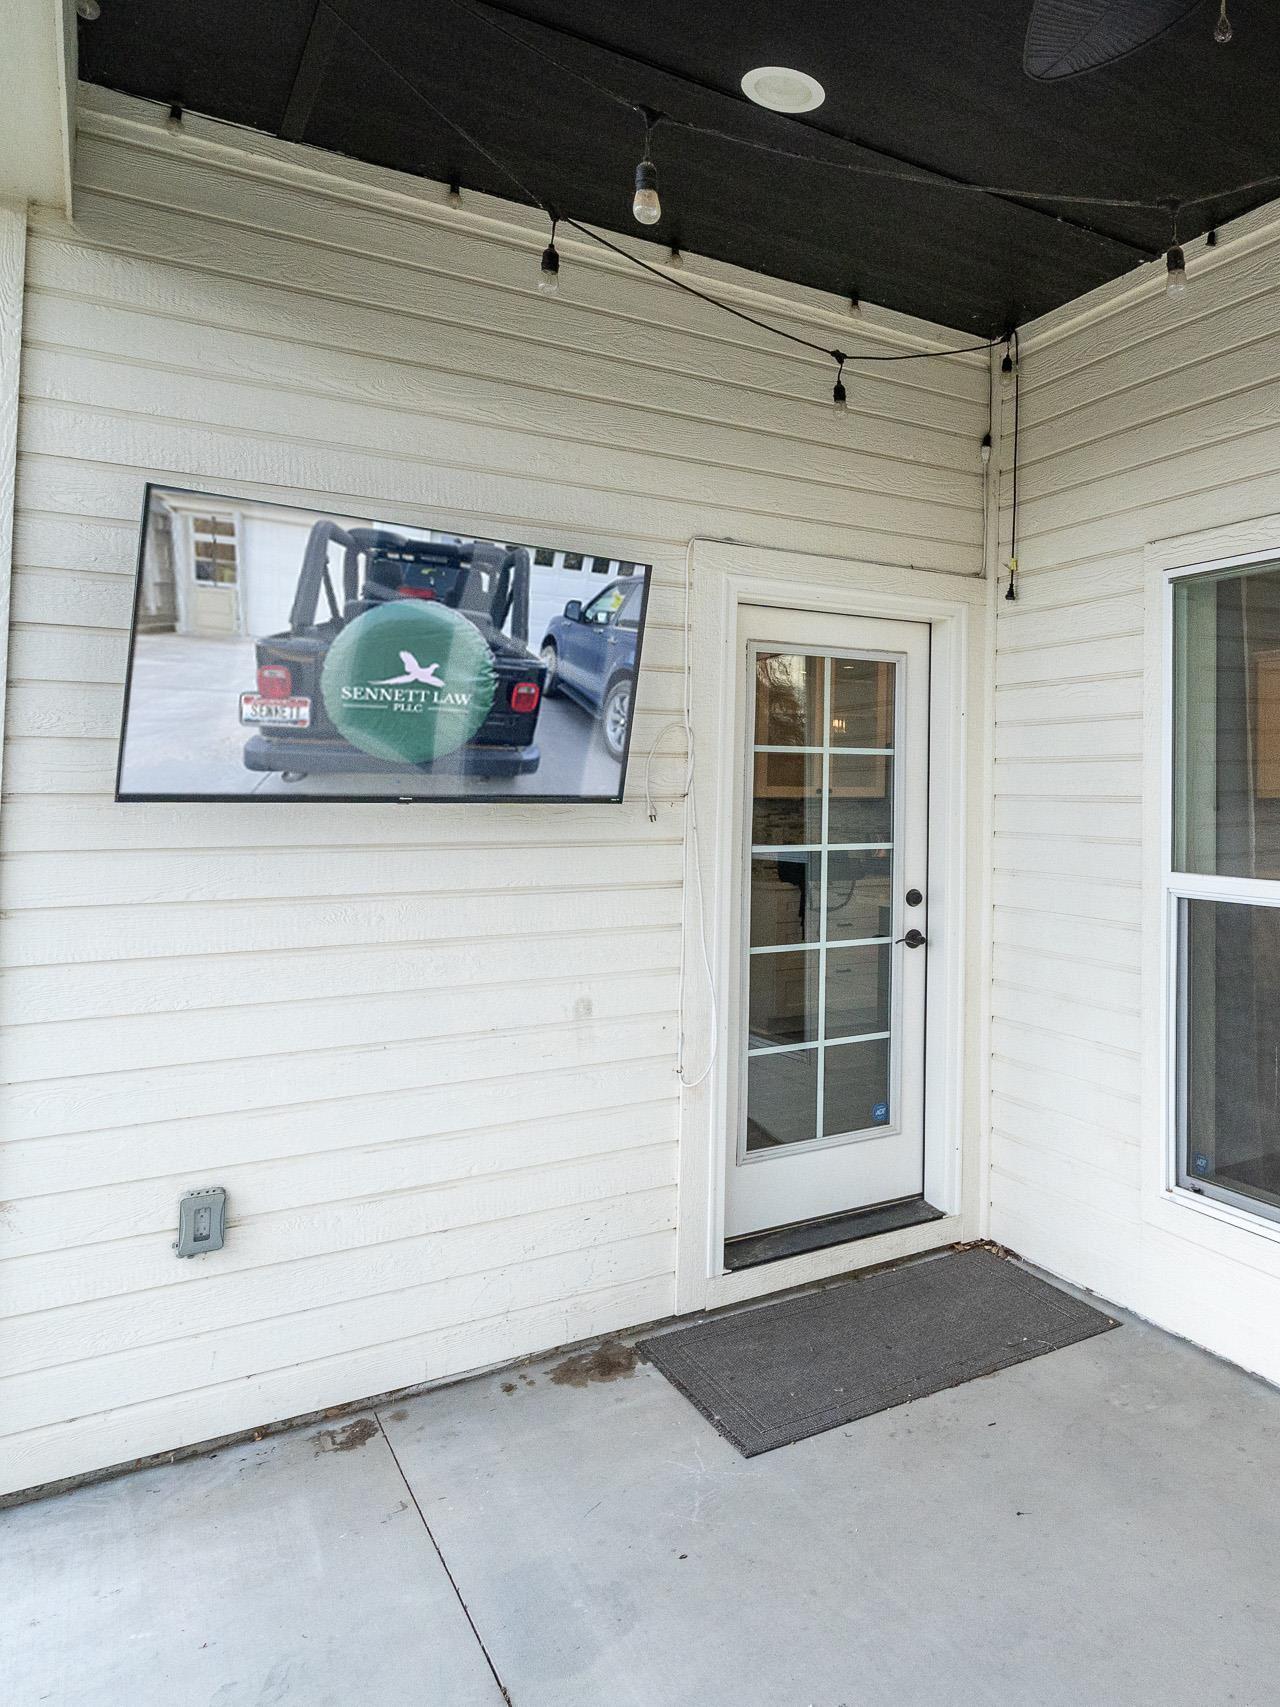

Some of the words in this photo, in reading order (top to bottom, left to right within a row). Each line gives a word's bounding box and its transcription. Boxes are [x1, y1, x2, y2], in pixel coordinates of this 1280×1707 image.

[341, 686, 430, 703] SENNETT
[432, 691, 472, 706] LAW
[393, 702, 424, 713] PLLC
